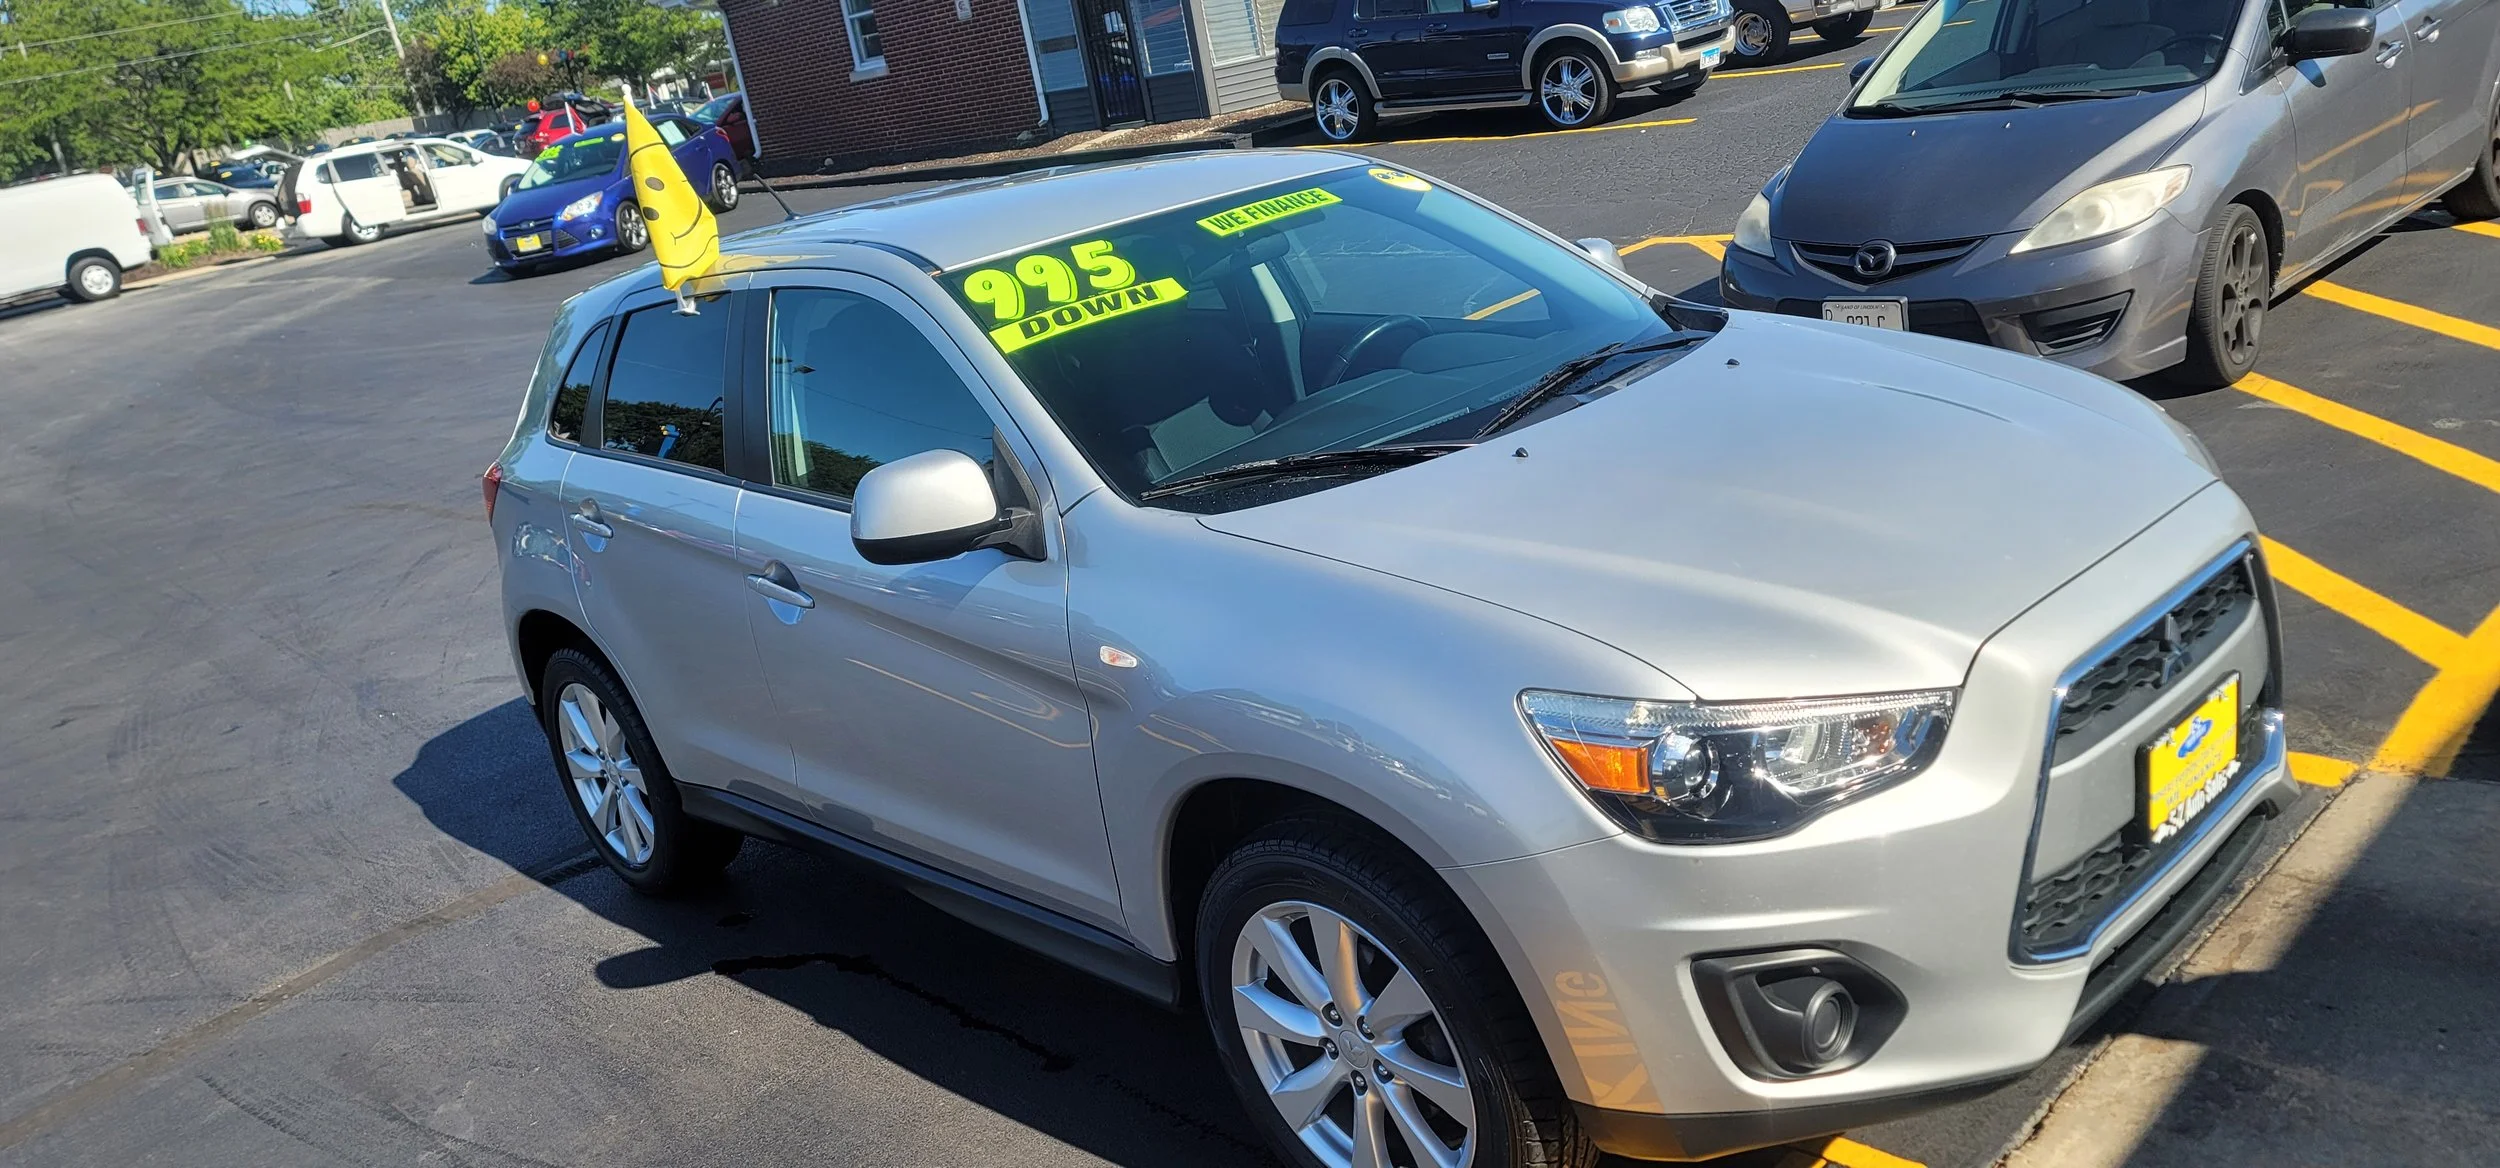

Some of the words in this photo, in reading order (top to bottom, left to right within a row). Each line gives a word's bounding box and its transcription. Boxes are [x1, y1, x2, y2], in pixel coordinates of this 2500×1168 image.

[1207, 211, 1247, 230] WE
[1241, 190, 1328, 220] FINANCE
[963, 239, 1136, 320] 995
[1018, 284, 1158, 340] DOWN
